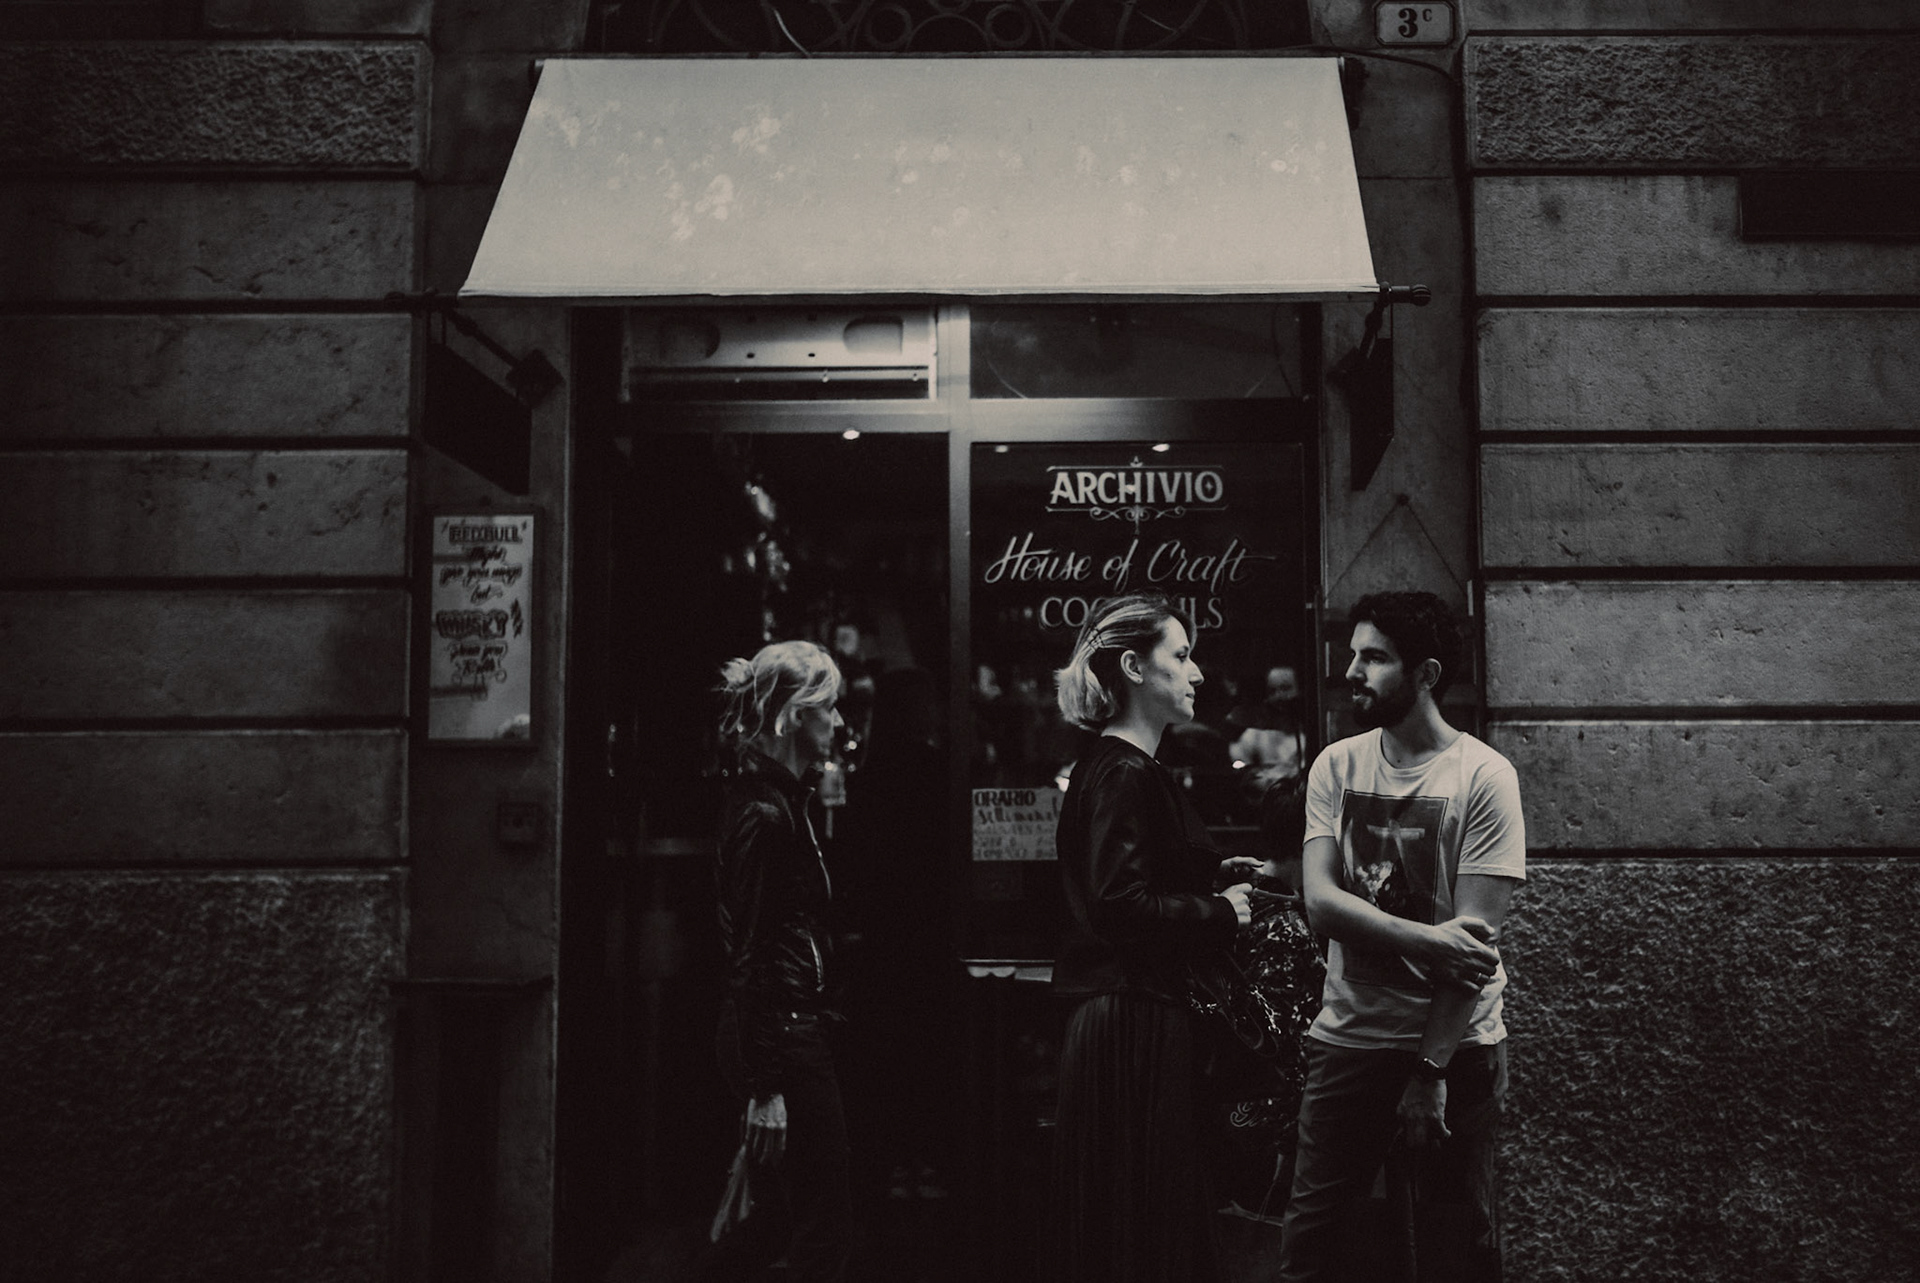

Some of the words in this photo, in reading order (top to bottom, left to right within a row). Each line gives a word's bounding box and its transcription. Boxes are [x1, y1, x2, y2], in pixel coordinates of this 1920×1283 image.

[1049, 470, 1224, 505] ARCHIVIO
[984, 531, 1094, 584] House
[1102, 538, 1139, 593] of
[1147, 537, 1277, 594] Craft
[1040, 596, 1224, 629] COILS
[974, 790, 1036, 807] ORARIO
